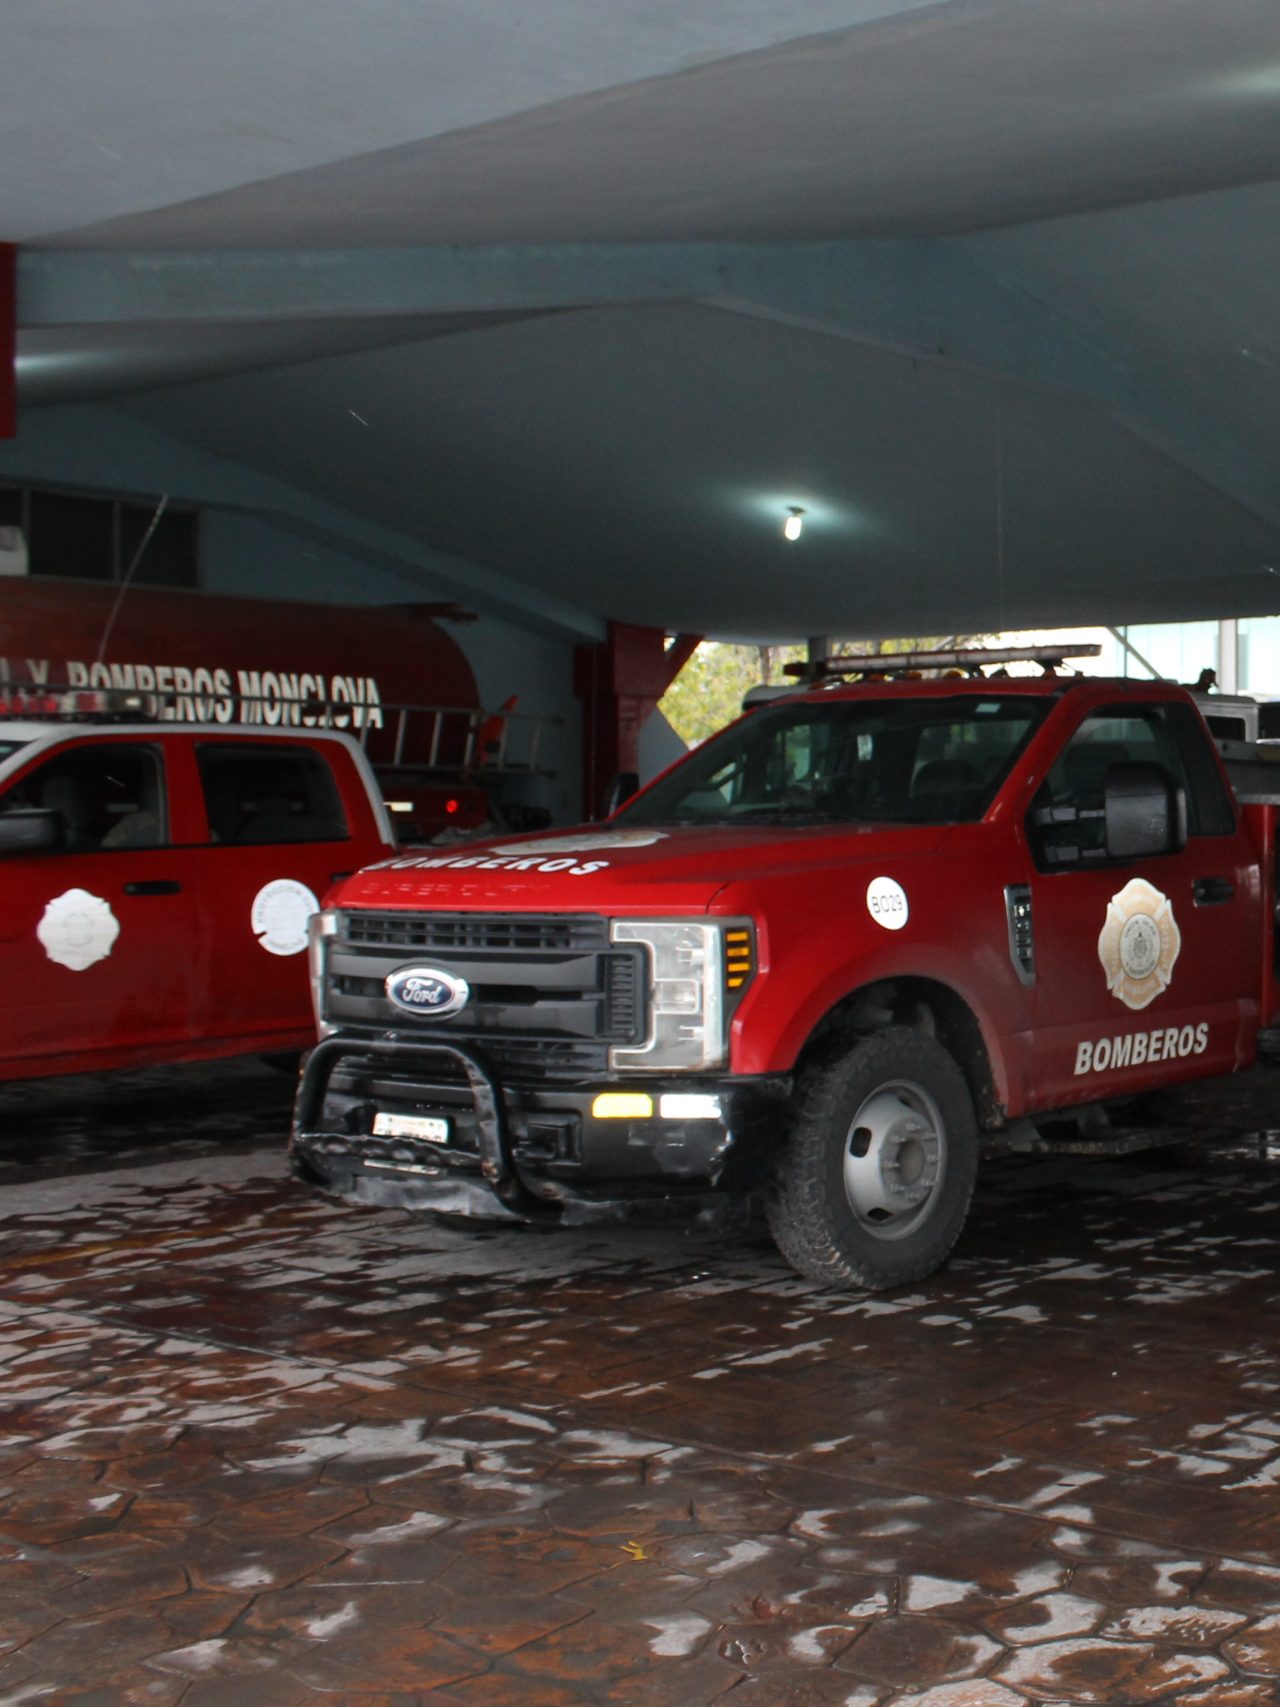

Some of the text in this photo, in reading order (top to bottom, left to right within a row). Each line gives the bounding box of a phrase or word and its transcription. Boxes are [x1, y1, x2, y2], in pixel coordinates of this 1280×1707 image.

[237, 669, 384, 730] MONCLOVA
[402, 977, 443, 1004] Ford
[1073, 1022, 1209, 1076] BOMBEROS
